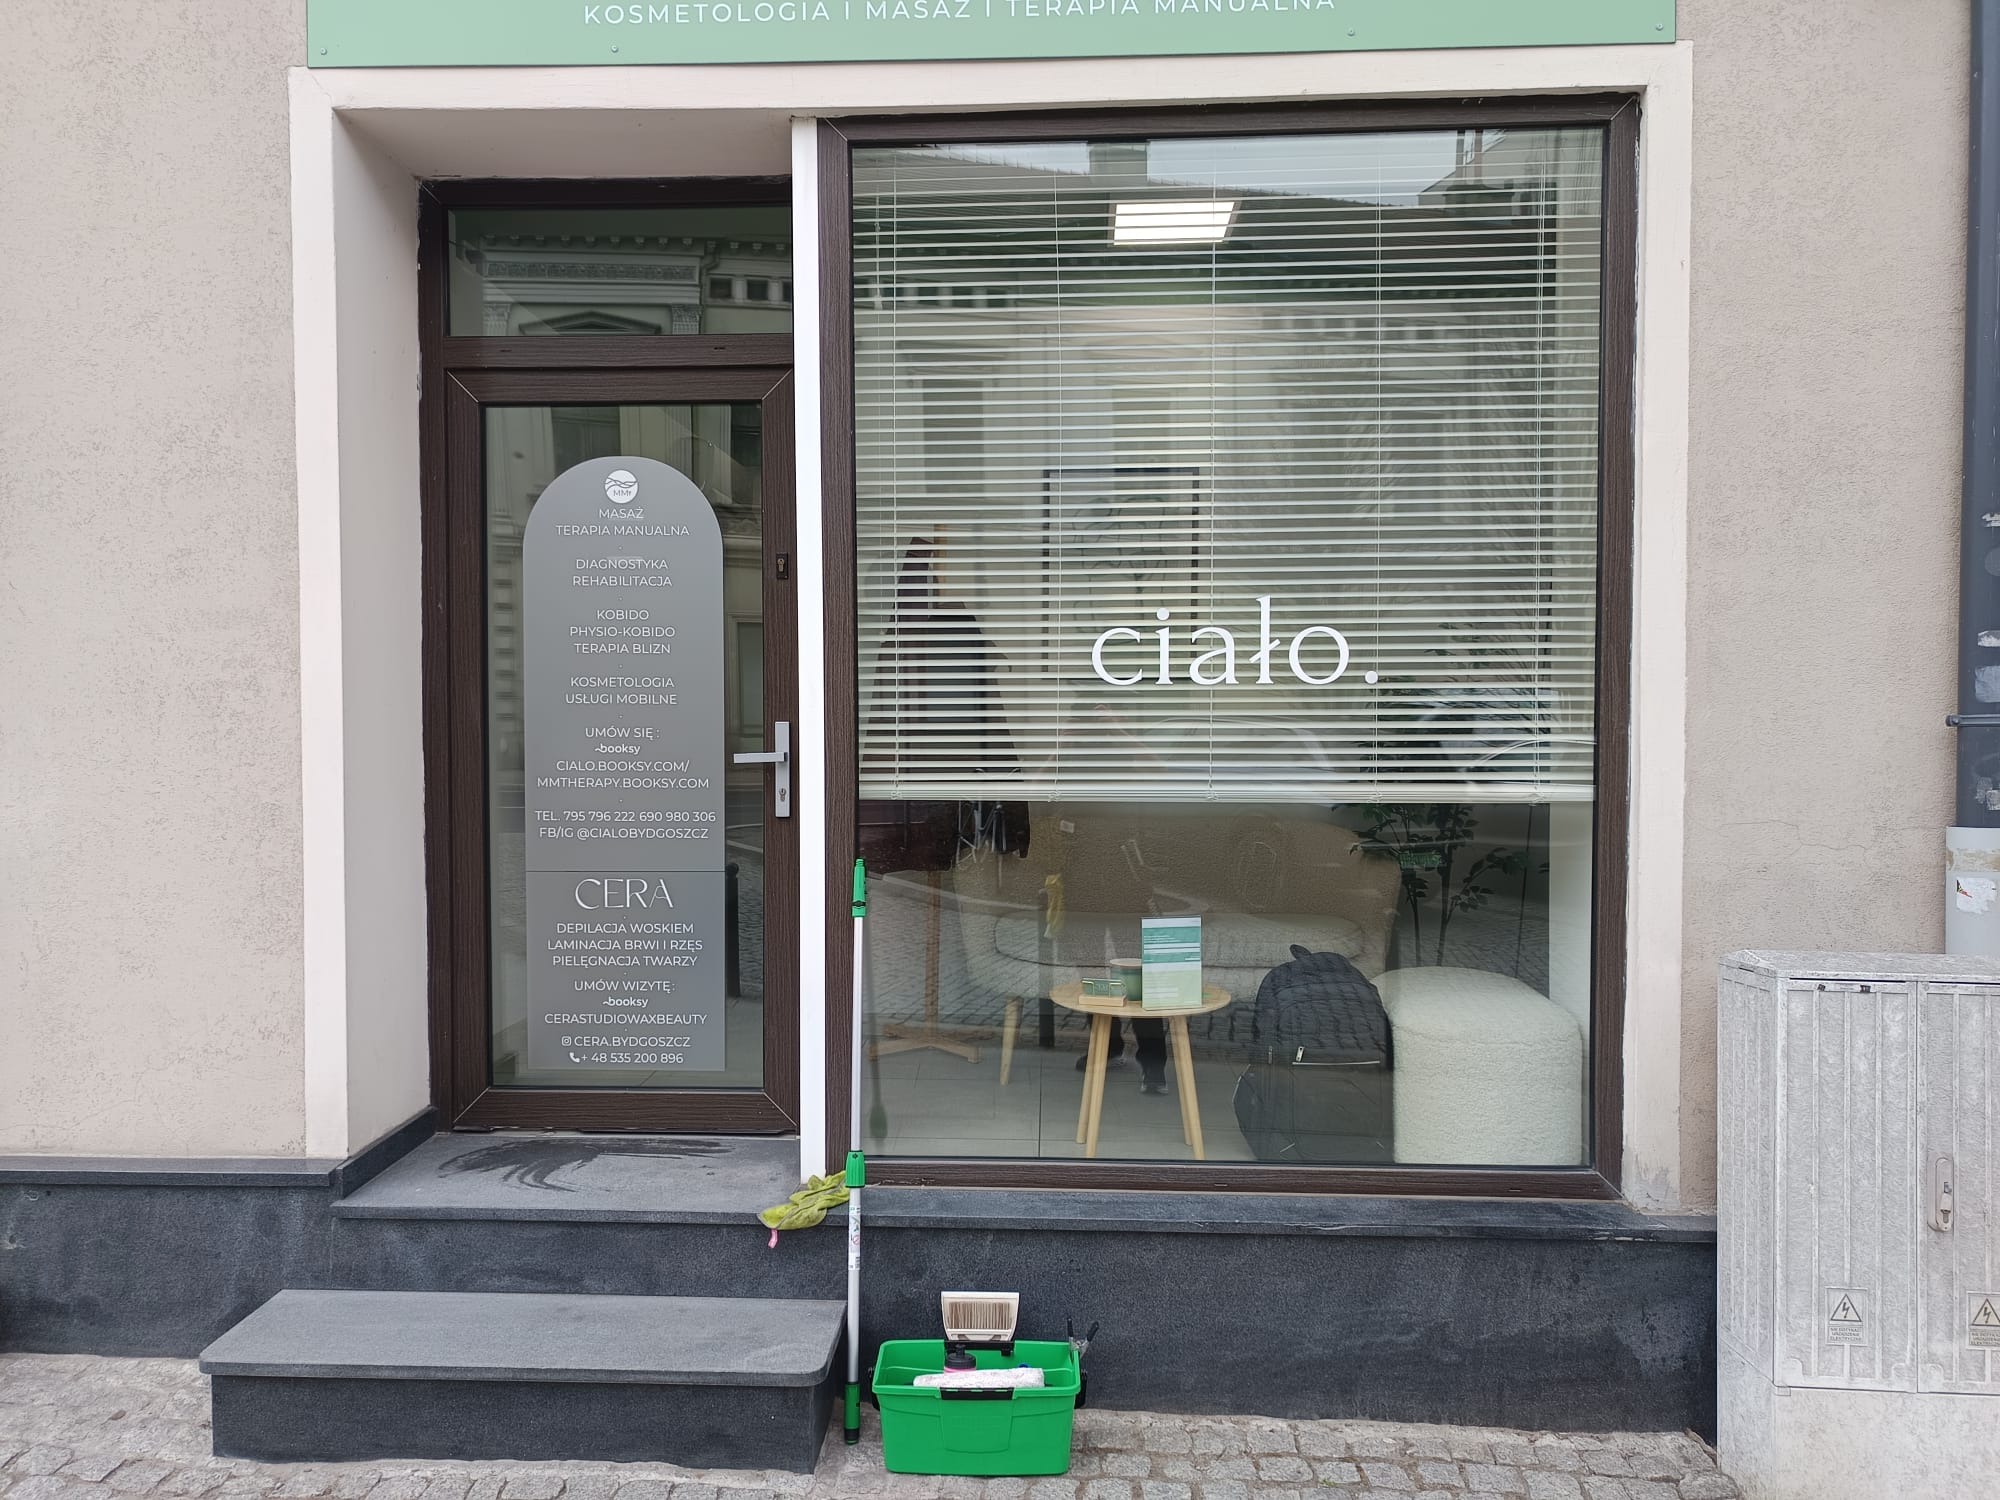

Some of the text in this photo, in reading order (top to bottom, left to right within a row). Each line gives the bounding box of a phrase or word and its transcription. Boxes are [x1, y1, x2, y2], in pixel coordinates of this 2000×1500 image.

[584, 1, 830, 24] KOSMETOLOGIA
[844, 1, 850, 21] I
[985, 0, 991, 18] I
[1005, 0, 1140, 17] TERAPIA
[599, 507, 645, 519] MASAŻ
[555, 525, 690, 536] TERAPIA MANUALNA
[576, 559, 669, 570] DIAGNOSTYKA
[572, 576, 673, 587] REHABILITACJA
[596, 609, 649, 620] KOBIDO
[569, 626, 676, 637] PHYSIO-KOBIDO
[1090, 594, 1379, 686] ciało.
[574, 643, 671, 654] TERAPIA BLIZN
[570, 677, 674, 688] KOSMETOLOGIA
[565, 694, 677, 705] USŁUGI MOBILNE
[585, 725, 630, 738] UMÓW
[556, 760, 690, 772] CIALO.BOOKSY.COM/
[537, 777, 709, 789] MMTHERAPY.BOOKSY.COM
[535, 810, 716, 822] TEL. 795 796 222 690 980 306
[539, 827, 709, 840] FB/IG @CIALOBYDGOSZCZ
[575, 878, 674, 910] CERA
[556, 923, 694, 934] DEPILACJA WOSKIEM
[547, 939, 621, 950] LAMINACJA
[624, 939, 659, 950] BRWI
[670, 940, 703, 952] RZĘS
[552, 956, 698, 969] PIELĘGNACJA TWARZY
[574, 979, 619, 991] UMÓW
[544, 1014, 708, 1025] CERASTUDIOWAXBEAUTY
[574, 1036, 691, 1047] CERA.BYDGOSZCZ
[591, 1053, 608, 1063] 48
[610, 1053, 631, 1063] 535
[634, 1053, 658, 1063] 200
[660, 1053, 684, 1063] 896
